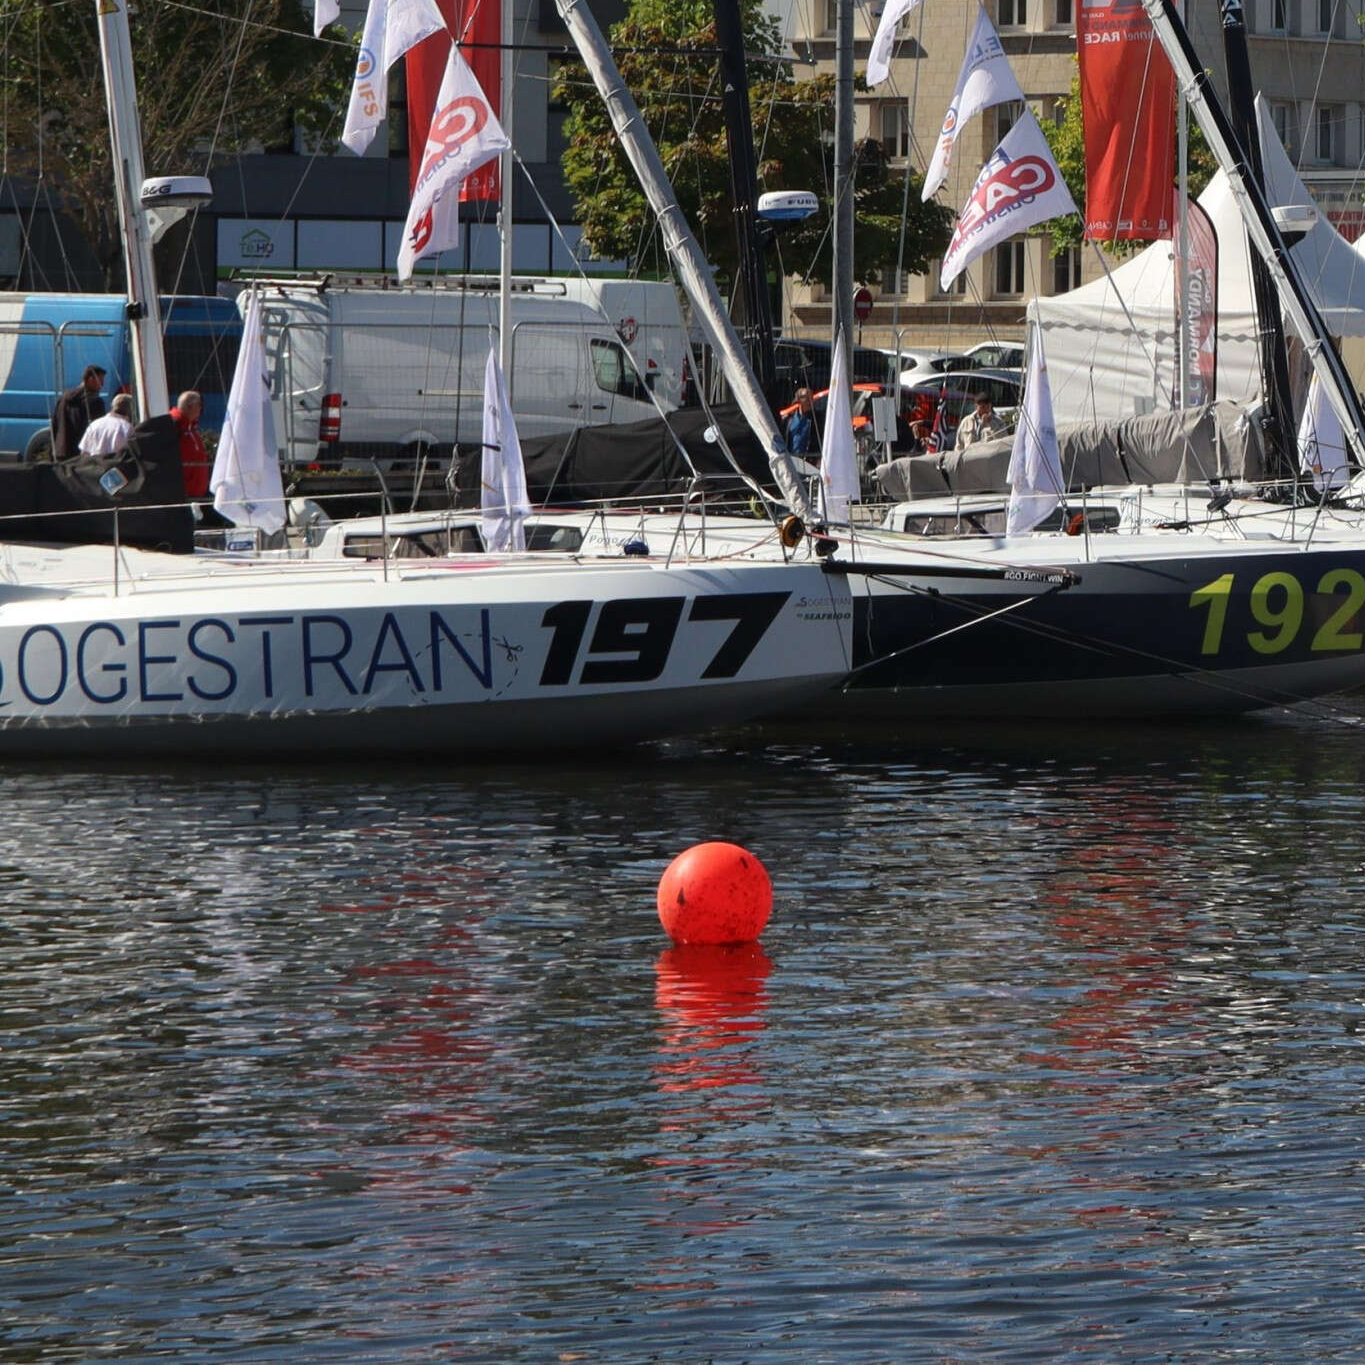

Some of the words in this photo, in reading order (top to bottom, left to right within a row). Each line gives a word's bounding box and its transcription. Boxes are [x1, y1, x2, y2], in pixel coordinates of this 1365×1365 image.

[355, 82, 379, 117] IFS
[143, 185, 171, 195] B&G
[0, 609, 492, 706] OGESTRAN
[539, 591, 793, 686] 197
